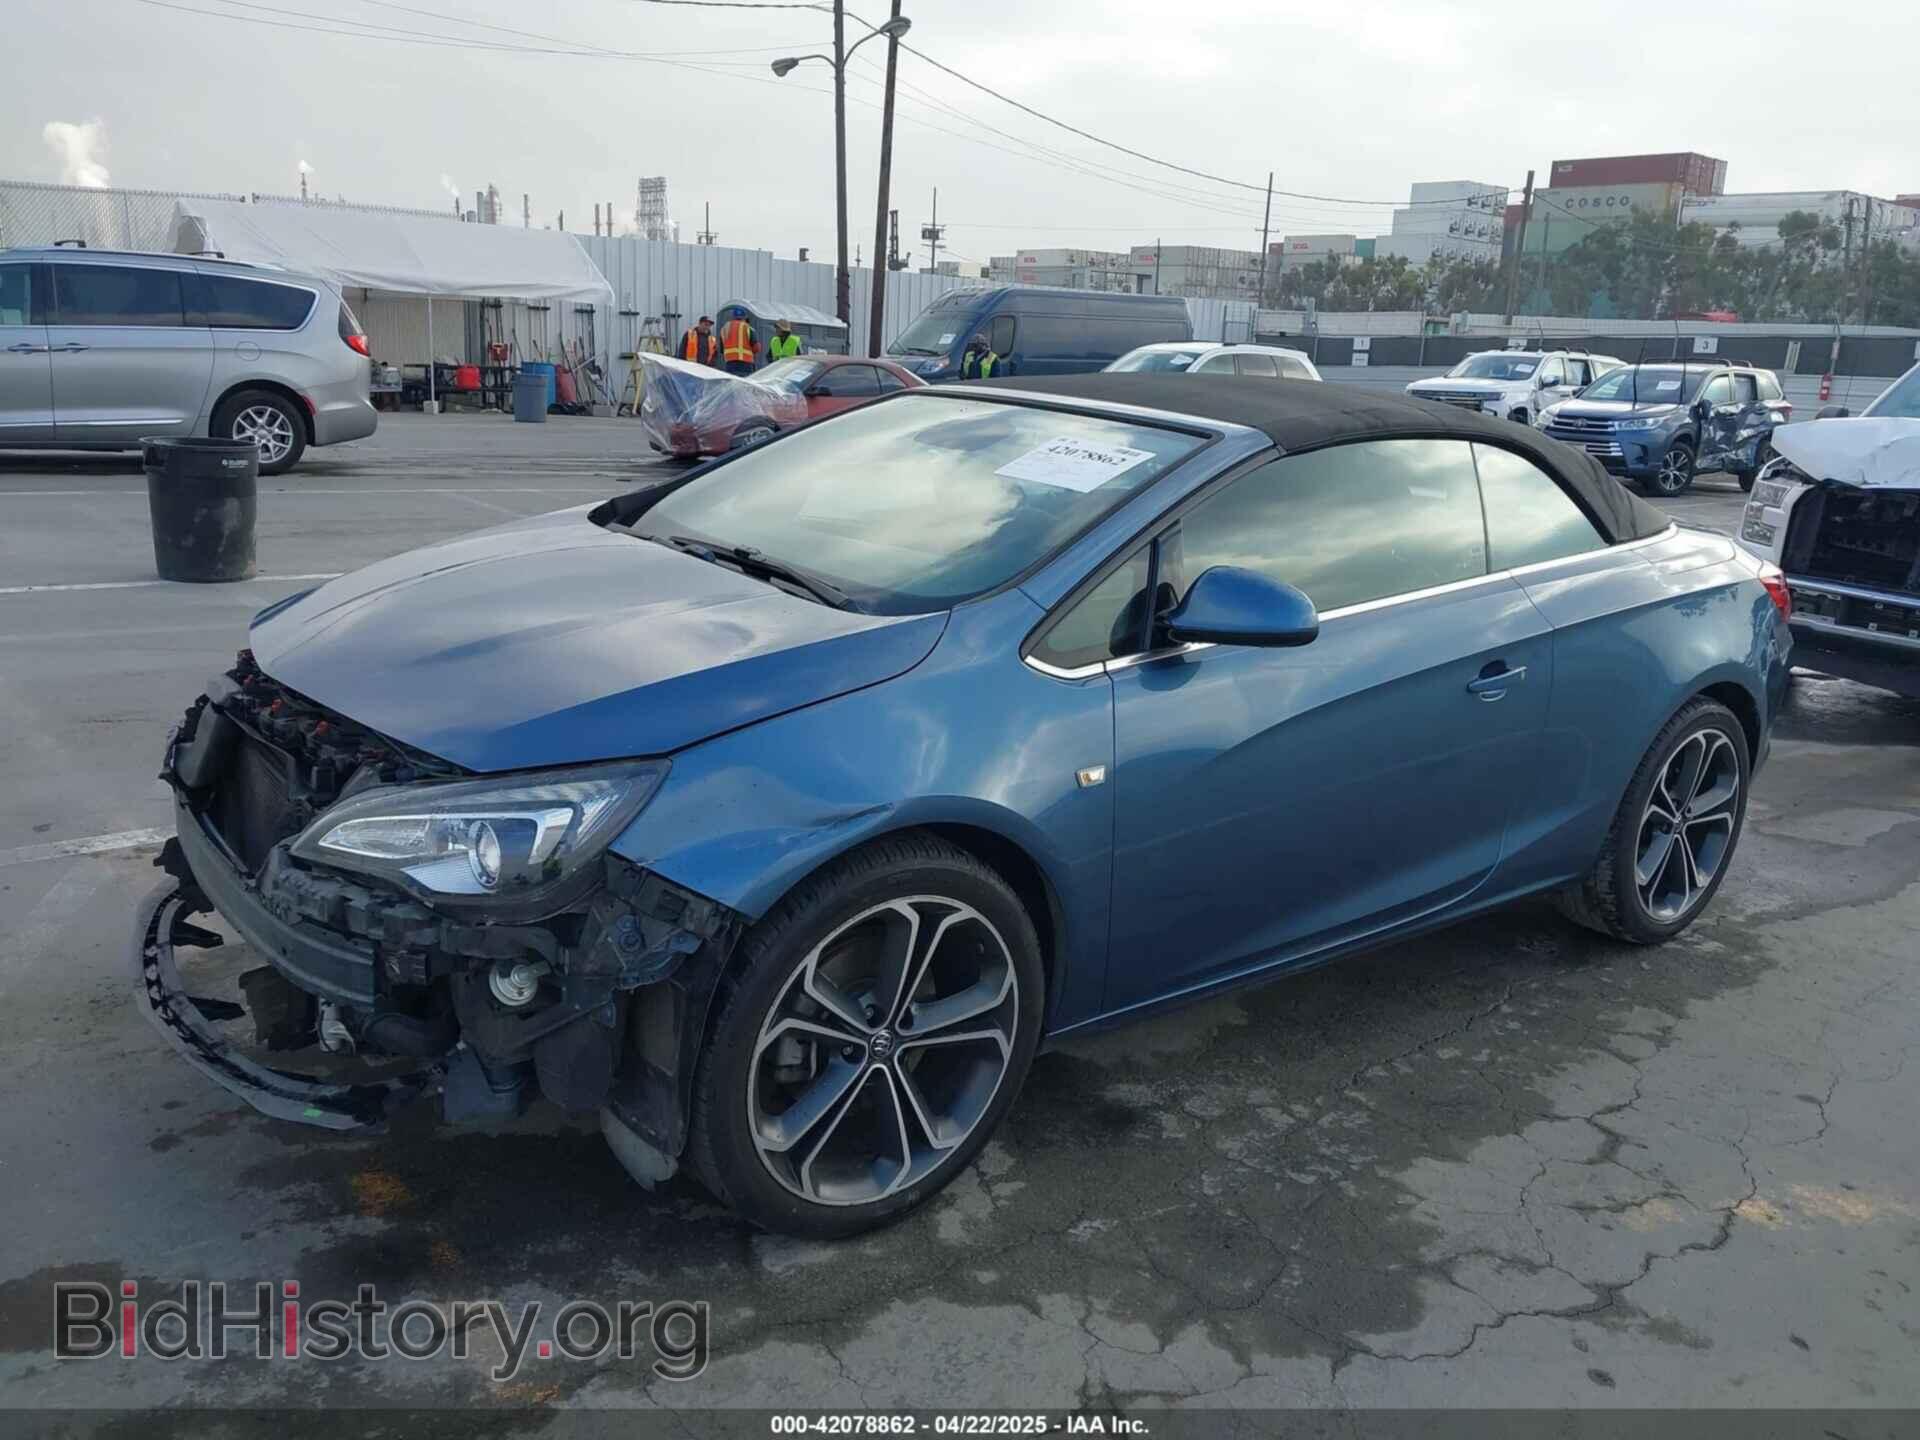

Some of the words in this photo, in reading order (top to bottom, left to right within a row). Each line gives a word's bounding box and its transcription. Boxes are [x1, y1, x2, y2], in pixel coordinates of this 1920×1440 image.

[1565, 194, 1631, 209] COSCO
[1702, 340, 1710, 350] 3
[1047, 445, 1127, 466] 42078862
